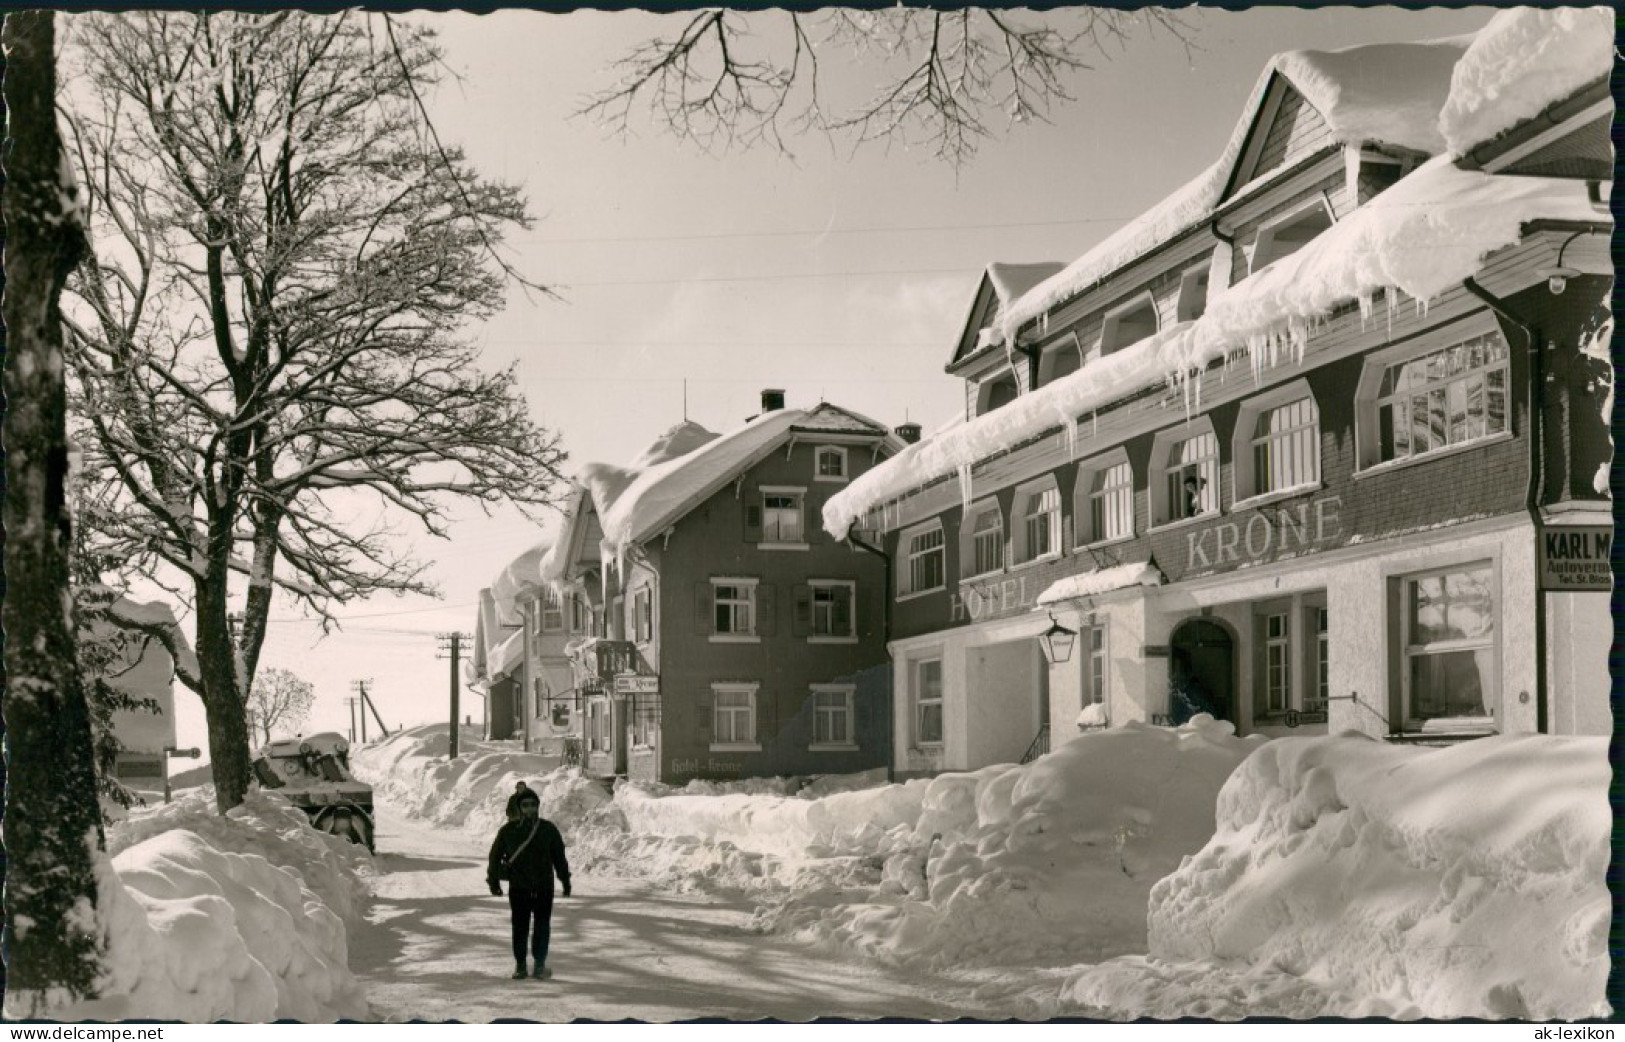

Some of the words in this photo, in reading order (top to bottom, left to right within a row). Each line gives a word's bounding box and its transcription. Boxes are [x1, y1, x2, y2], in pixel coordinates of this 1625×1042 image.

[949, 575, 1031, 622] HOTEL
[1186, 495, 1344, 572] KRONE
[1546, 533, 1591, 559] KARL
